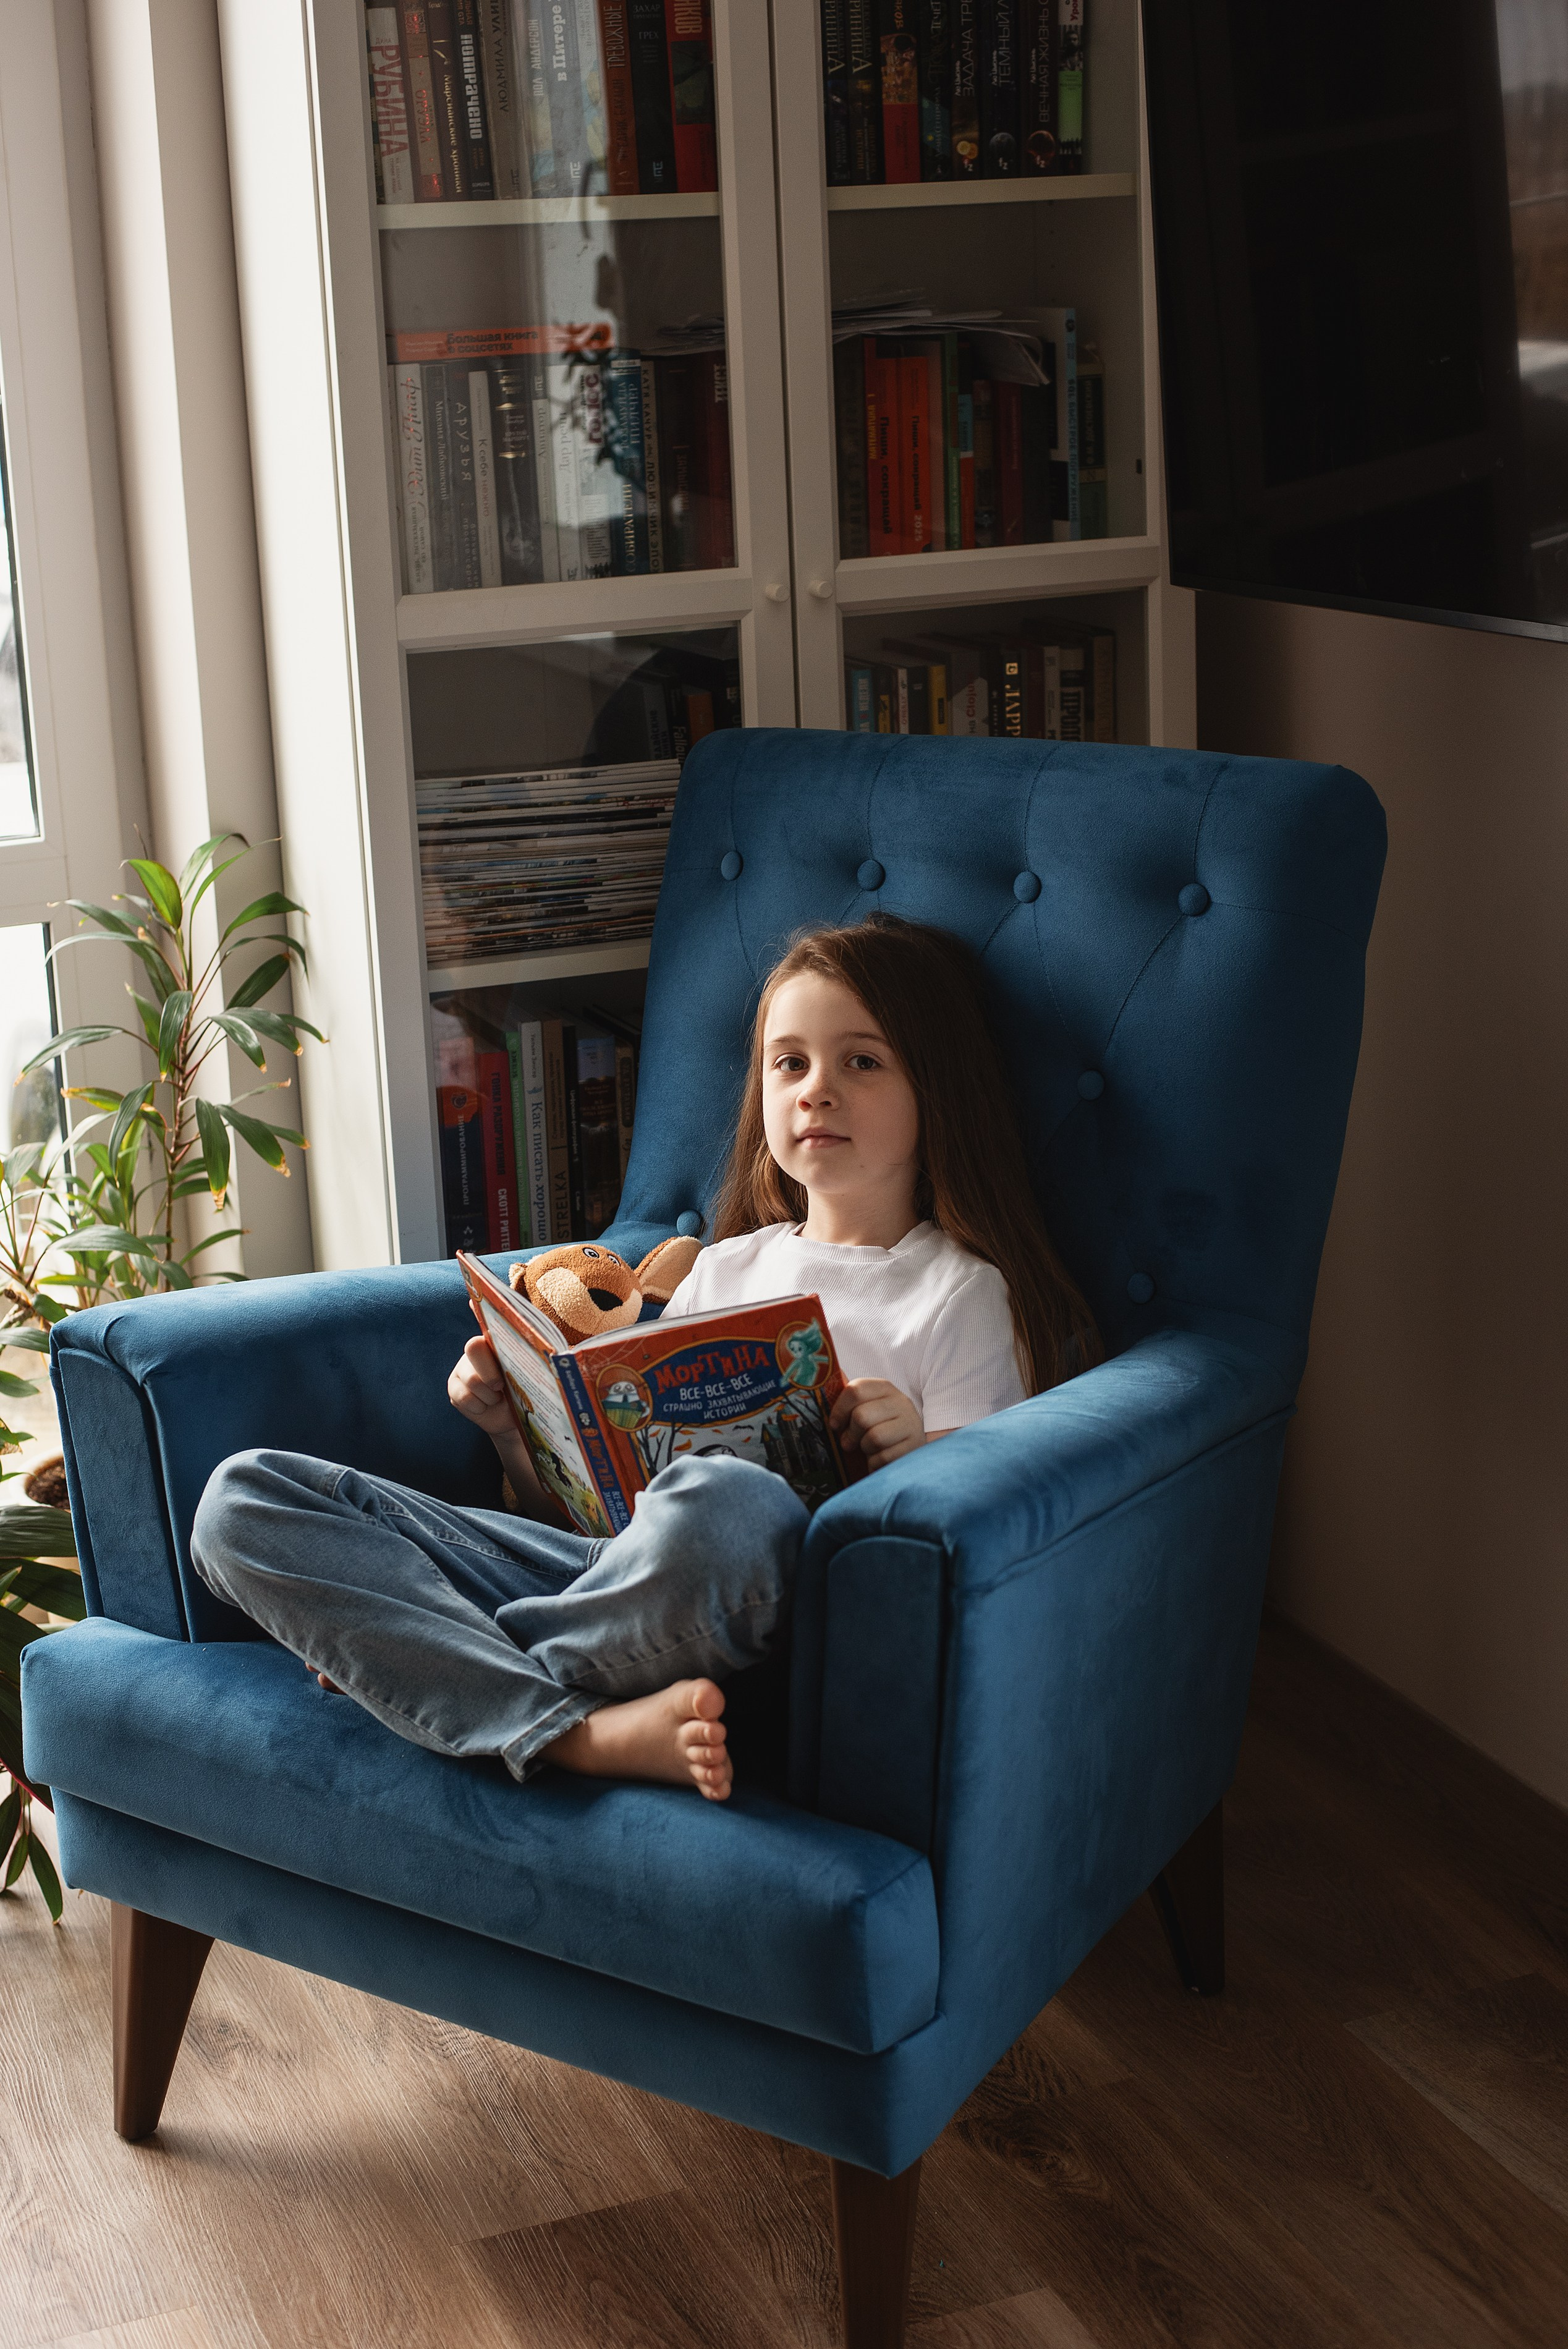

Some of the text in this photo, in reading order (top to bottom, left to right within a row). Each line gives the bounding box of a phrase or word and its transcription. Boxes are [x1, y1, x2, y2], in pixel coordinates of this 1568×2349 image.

[603, 5, 625, 69] ТРЕВОЖНЫЕ
[633, 4, 661, 14] ЗАХАР
[638, 31, 659, 40] ГРЕХ
[528, 19, 543, 96] ПОЛ АНДЕРСОН
[552, 5, 567, 82] в Питере
[961, 28, 975, 96] ЗАДАЧА
[995, 11, 1012, 87] ТЕМНЫЙ
[1037, 8, 1050, 123] ВЕЧНАЯ ЖИЗНЬ
[370, 45, 409, 157] РУБИНА
[494, 38, 509, 112] ЛЮДМИЛА
[415, 89, 431, 144] ОРУЭЛЛ
[443, 74, 462, 193] Марсианские хроники
[855, 129, 865, 169] ИСТОРИИ
[446, 333, 502, 350] Большая
[503, 331, 538, 343] книга
[457, 343, 514, 354] соцсетях
[400, 376, 425, 496] Эдит Пиаф
[434, 401, 444, 440] Михаил
[453, 402, 472, 481] ДРУЗЬЯ
[537, 407, 547, 460] Авиатор
[617, 381, 630, 450] РОЗАМУНДА
[628, 382, 641, 445] ПИЛЧЕР
[643, 402, 651, 440] КАЧУР
[911, 415, 920, 451] Пиши,
[438, 442, 449, 501] Лабковский
[479, 450, 489, 477] себе
[559, 447, 572, 473] Дар
[879, 417, 893, 535] Пиши, сокращай
[912, 453, 922, 511] сокращай
[481, 478, 490, 517] нежно
[622, 483, 637, 572] СОБИРАТЕЛИ
[491, 1072, 506, 1176] ГОНКА РАЗОРУЖЕНИЯ
[457, 1115, 470, 1205] ПРОГРАММИРОВАНИЕ
[531, 1101, 549, 1241] Как писать хорошо
[497, 1187, 509, 1217] СКОТТ
[554, 1171, 570, 1240] STRELKA
[653, 1342, 771, 1395] МОРТИНА
[663, 1379, 777, 1414] СТРАШНО ЗАХВАТЫВАЮЩИЕ
[678, 1373, 753, 1402] ВСЕ-ВСЕ-ВСЕ
[703, 1403, 747, 1419] ИСТОРИИ
[611, 1490, 629, 1522] ВСЕ-ВСЕ-ВСЕ
